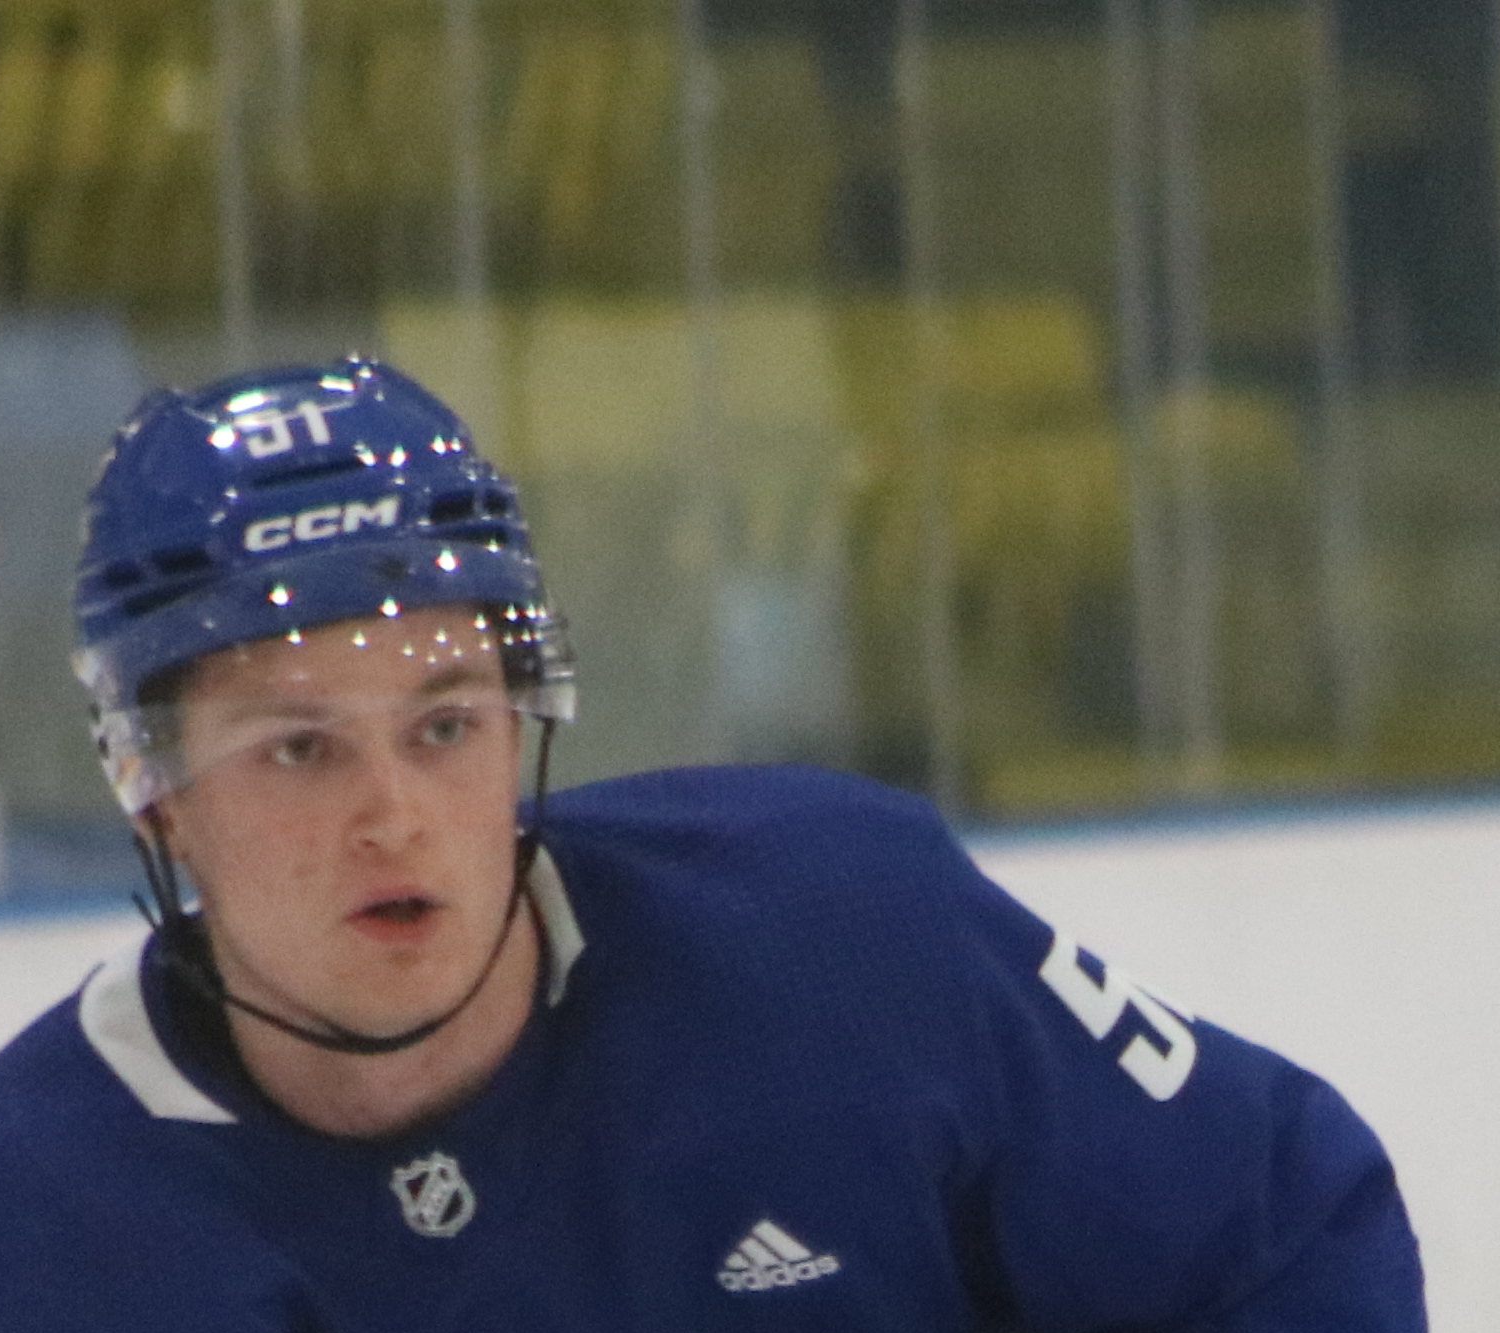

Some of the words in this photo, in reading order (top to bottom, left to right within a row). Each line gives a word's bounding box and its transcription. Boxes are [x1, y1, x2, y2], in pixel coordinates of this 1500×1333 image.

[244, 496, 399, 552] CCM
[1037, 925, 1198, 1102] 5
[717, 1254, 841, 1292] adidas
